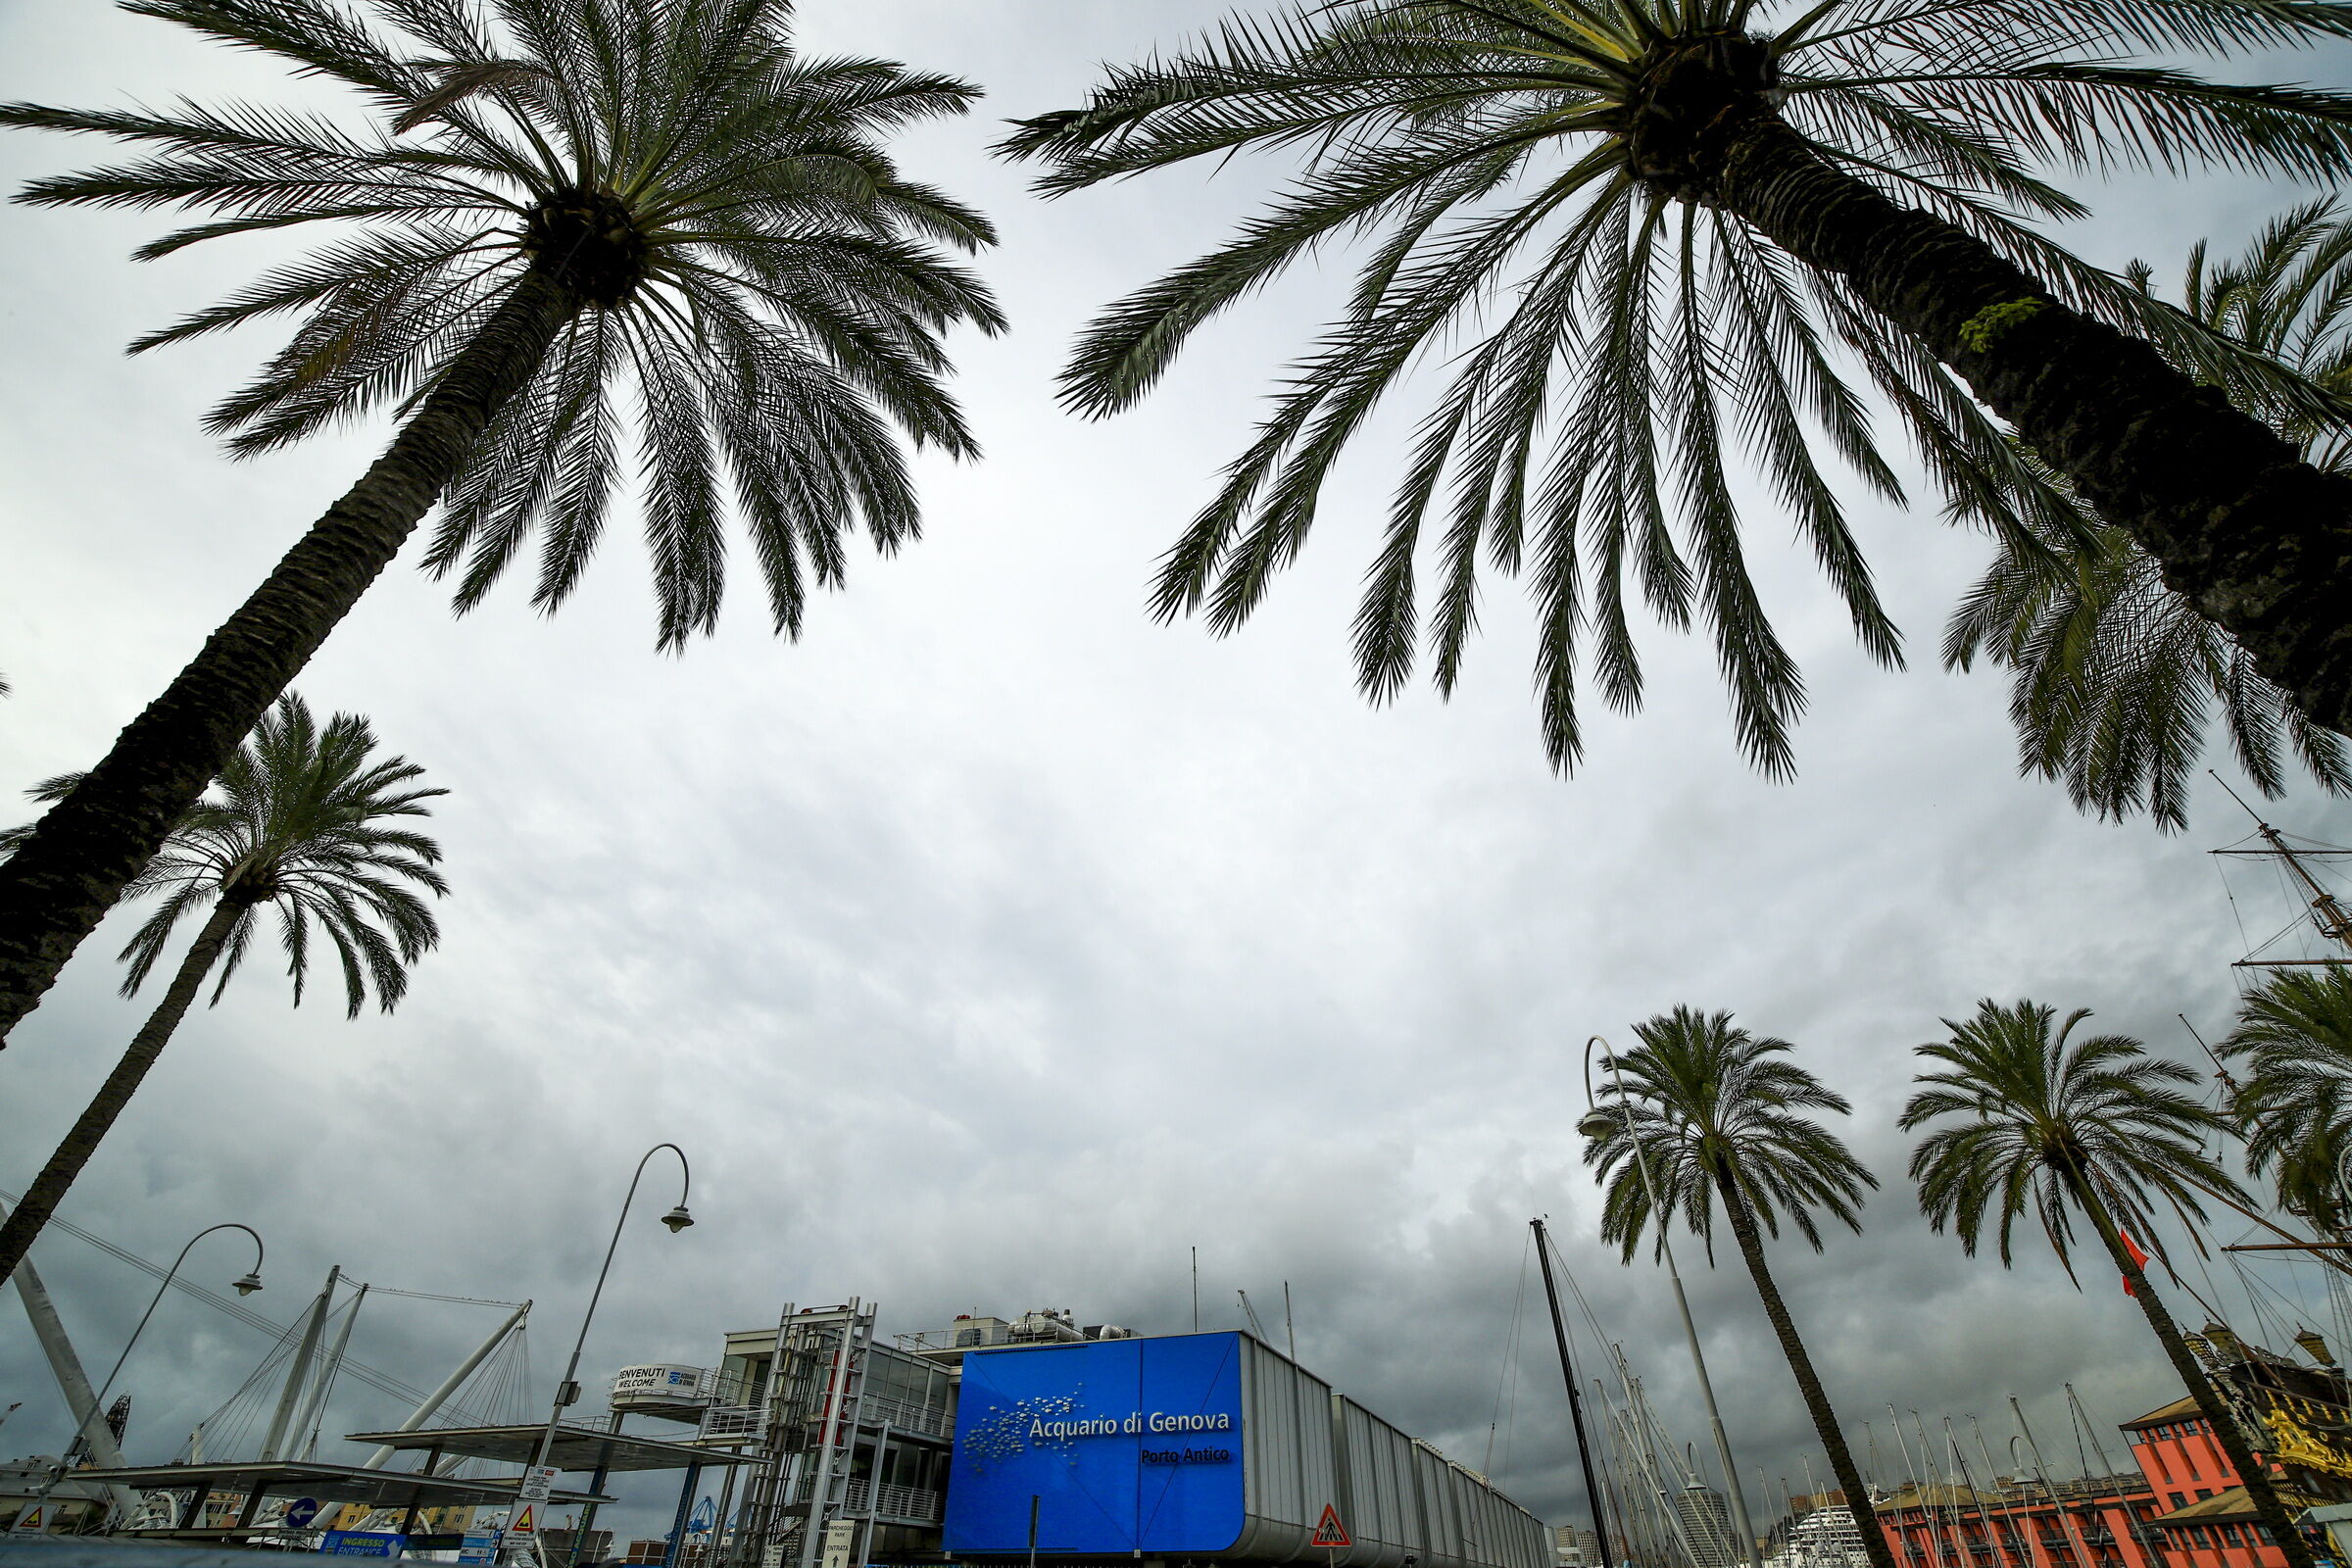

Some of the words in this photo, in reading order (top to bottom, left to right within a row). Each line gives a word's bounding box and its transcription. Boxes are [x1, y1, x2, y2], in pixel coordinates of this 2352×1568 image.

[618, 1368, 666, 1380] BENVENUTI
[618, 1378, 657, 1389] WELCOME
[1029, 1414, 1117, 1442] Acquario
[1123, 1412, 1142, 1434] di
[1150, 1411, 1230, 1433] Genova
[1141, 1449, 1179, 1464] Porto
[1183, 1446, 1229, 1462] Antico
[341, 1538, 385, 1547] INGRESSO
